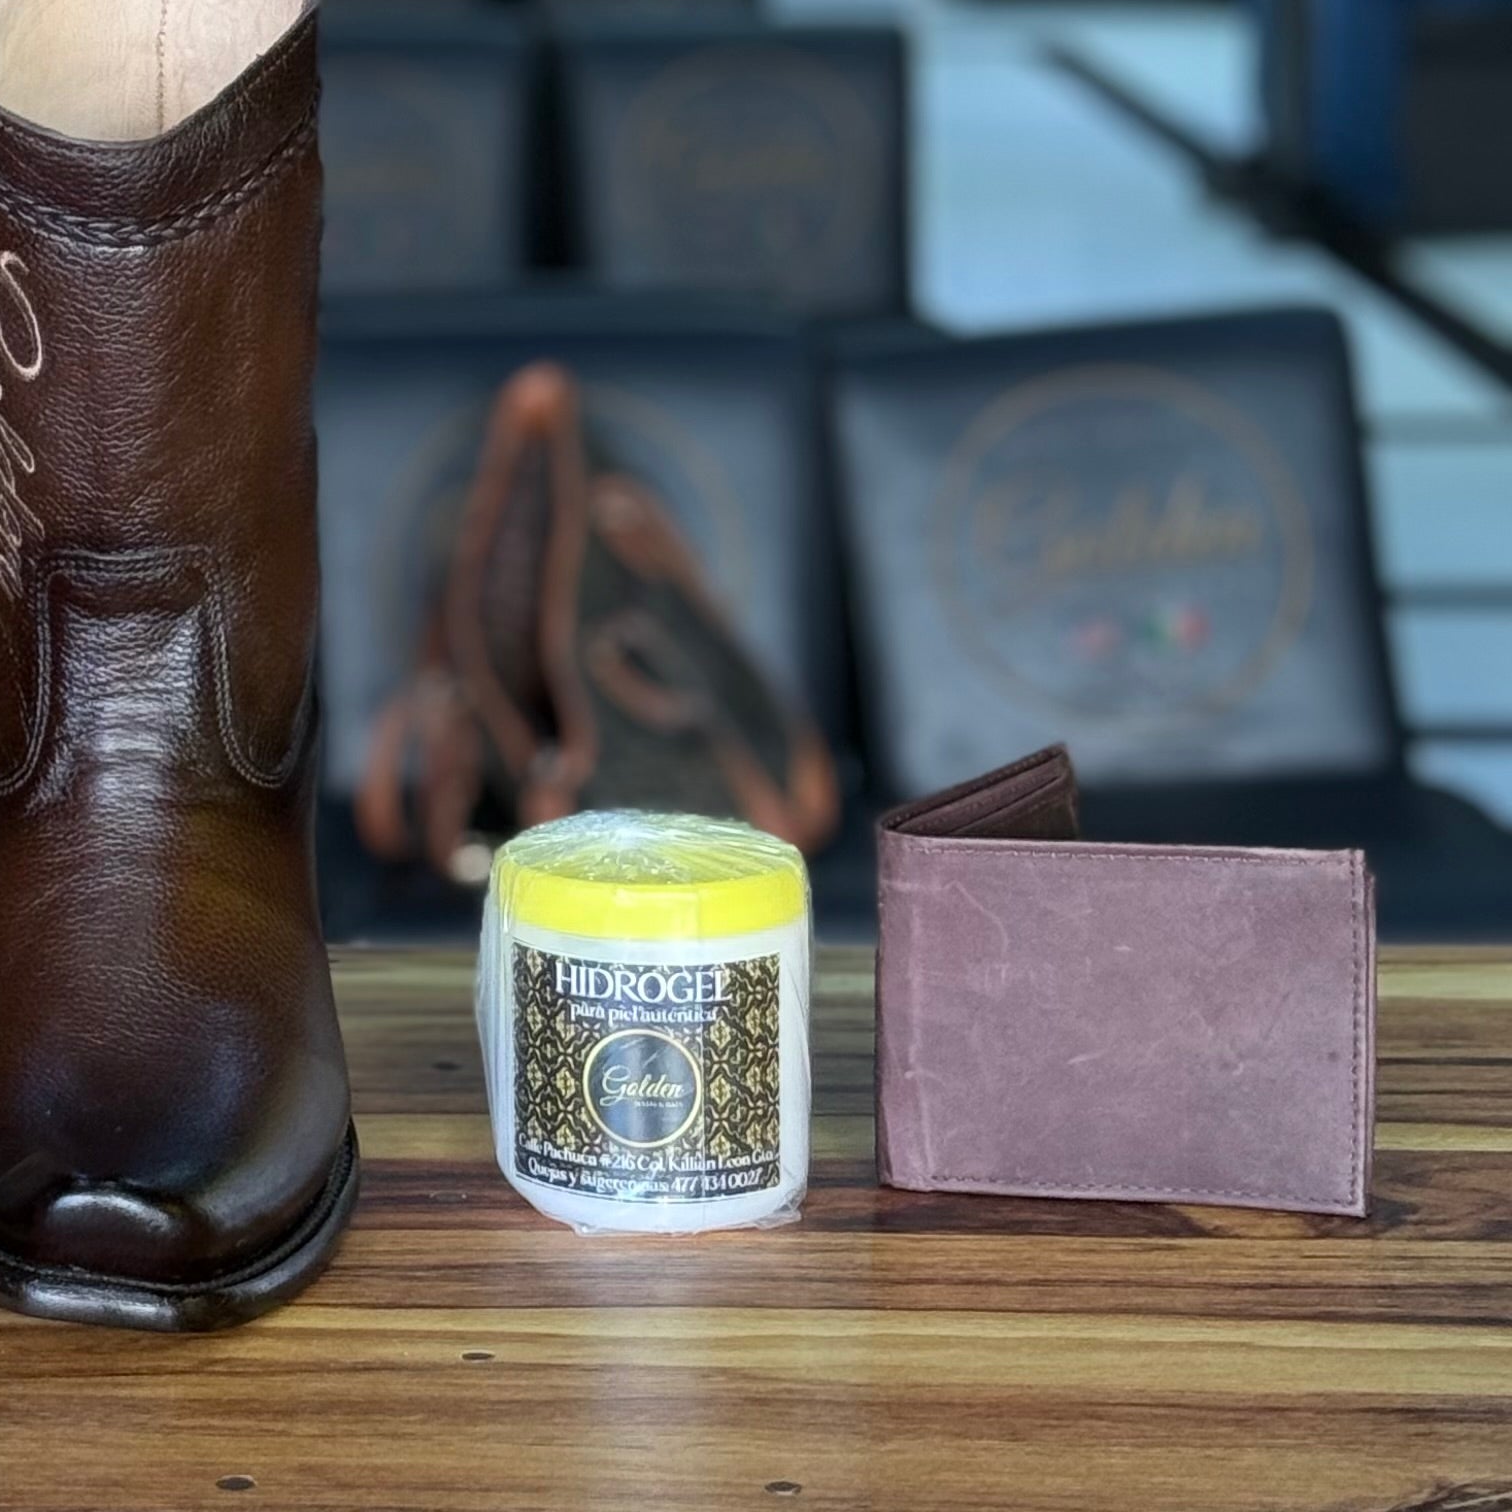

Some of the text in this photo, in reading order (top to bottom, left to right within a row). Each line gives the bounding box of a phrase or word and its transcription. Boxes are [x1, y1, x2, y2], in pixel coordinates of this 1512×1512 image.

[555, 962, 732, 1004] HIDROGEL
[571, 1001, 605, 1022] para
[608, 1005, 638, 1028] piel
[600, 1065, 685, 1106] Golden
[519, 1132, 542, 1154] Calle
[543, 1141, 597, 1166] Pachuca
